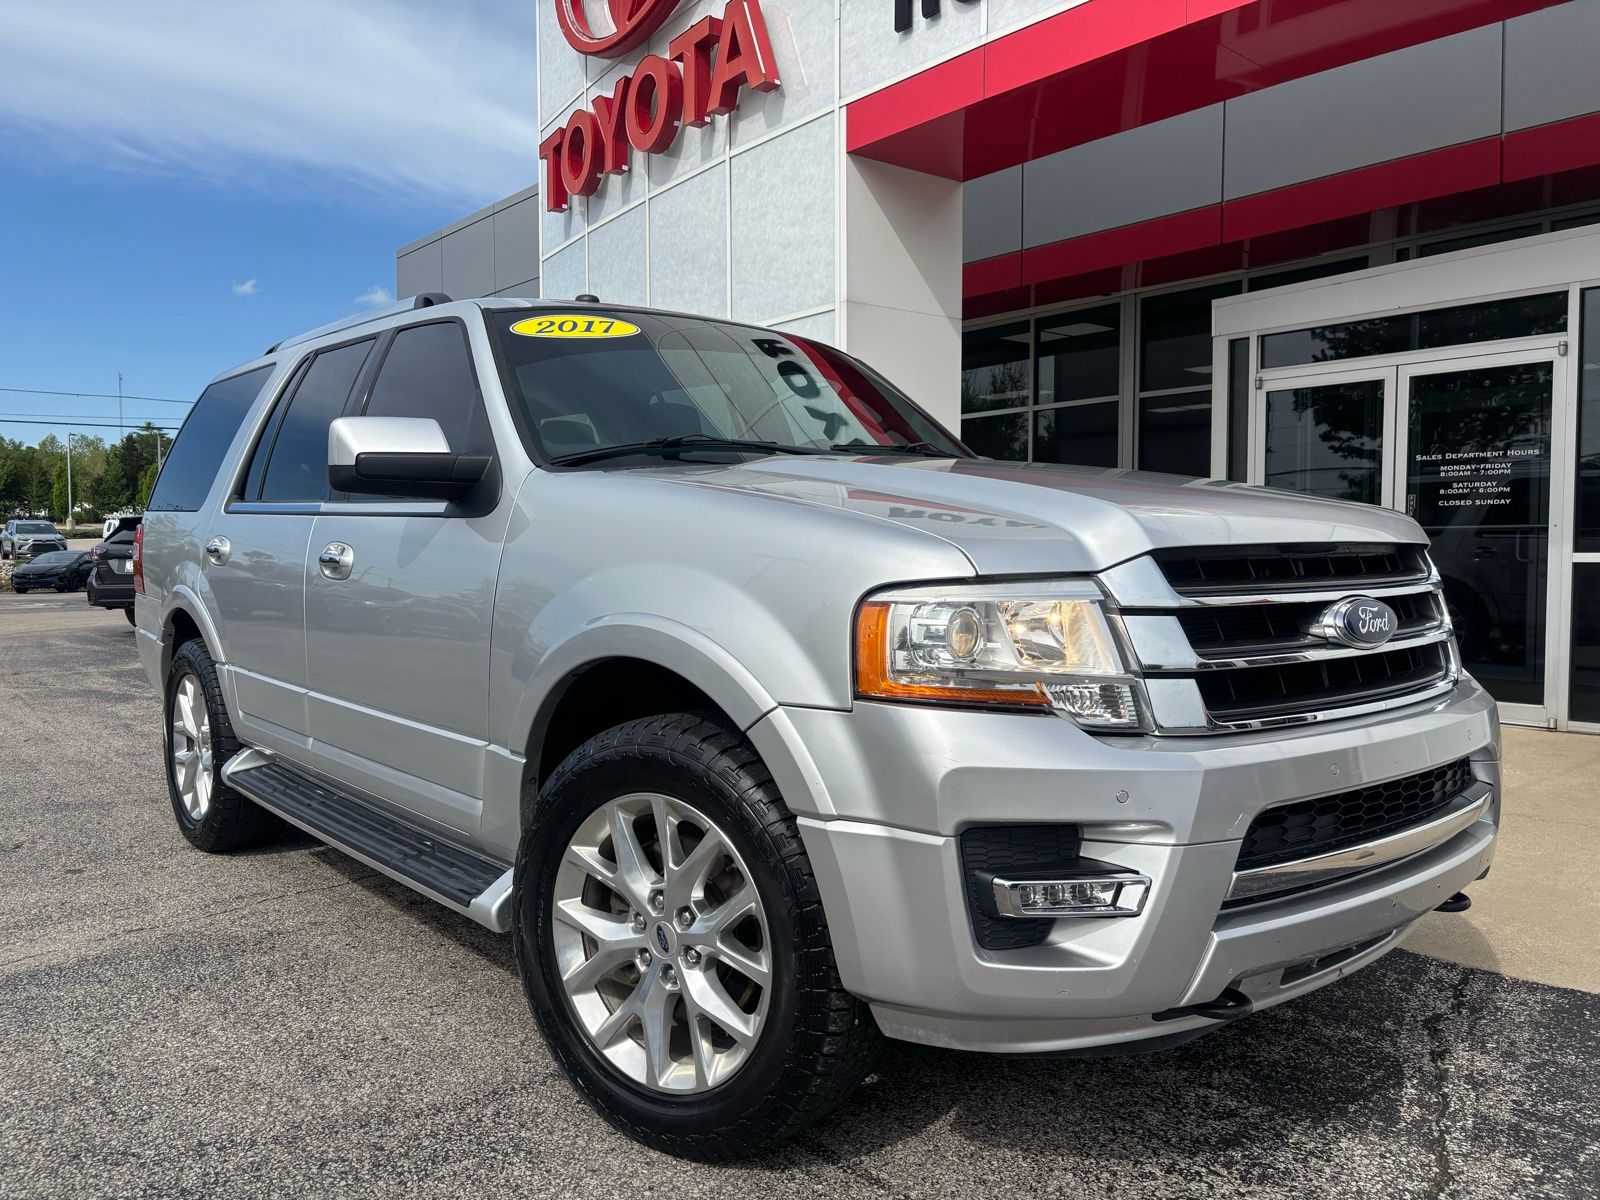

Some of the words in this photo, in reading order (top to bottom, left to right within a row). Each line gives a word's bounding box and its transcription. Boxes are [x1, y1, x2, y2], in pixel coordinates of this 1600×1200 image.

[539, 0, 780, 213] TOYOTA
[536, 320, 615, 334] 2017
[1358, 606, 1390, 634] Ford
